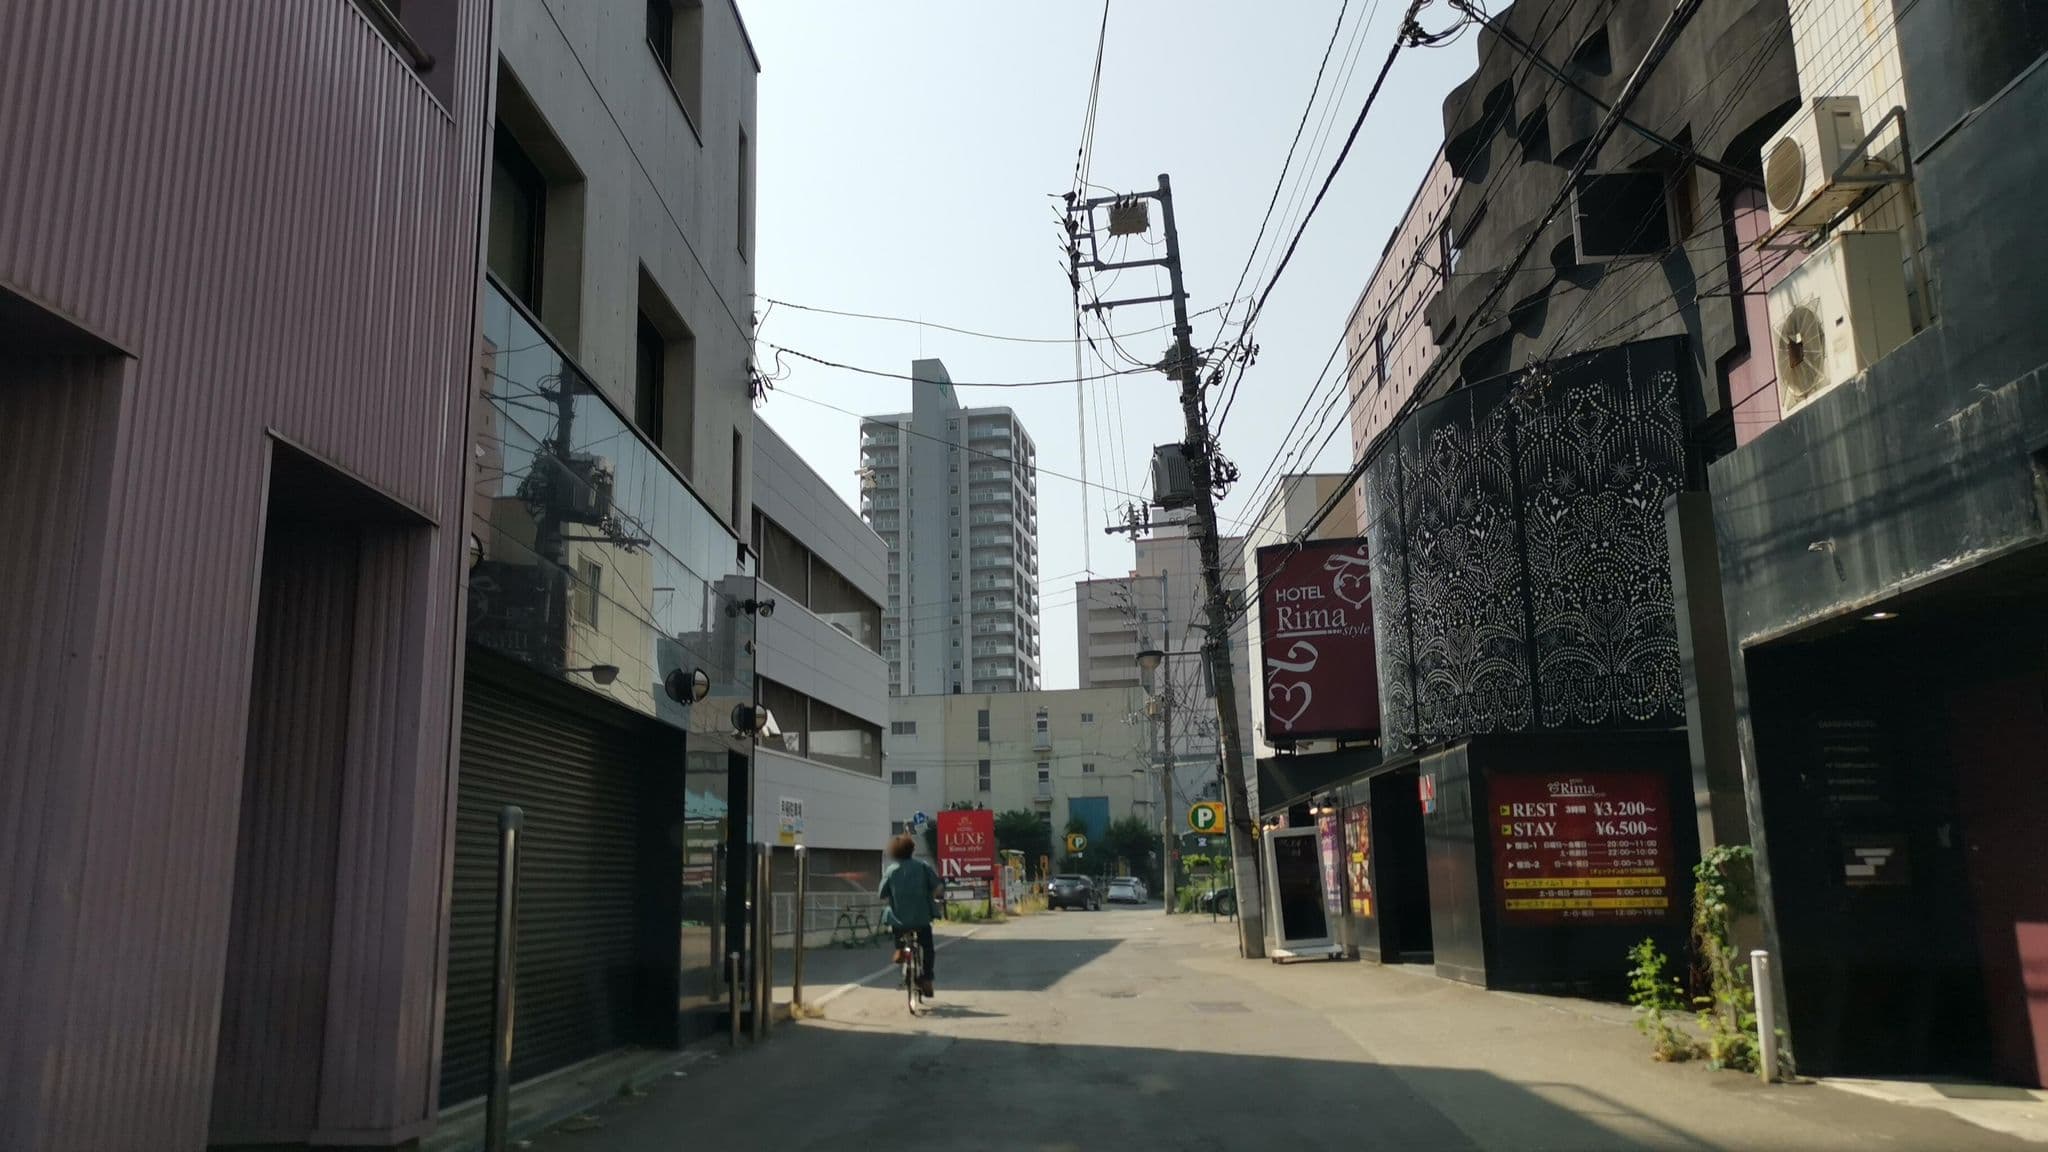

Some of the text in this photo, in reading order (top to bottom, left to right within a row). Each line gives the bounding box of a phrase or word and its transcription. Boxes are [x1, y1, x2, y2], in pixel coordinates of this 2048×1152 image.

[1276, 585, 1325, 602] HOTEL
[1277, 604, 1347, 632] Rima
[1343, 622, 1371, 640] style
[1560, 783, 1595, 795] Rima
[1197, 808, 1213, 828] P
[1512, 803, 1558, 817] REST
[1513, 822, 1557, 837] STAY
[944, 832, 985, 846] LUXE
[1075, 837, 1084, 849] P
[941, 858, 962, 877] IN
